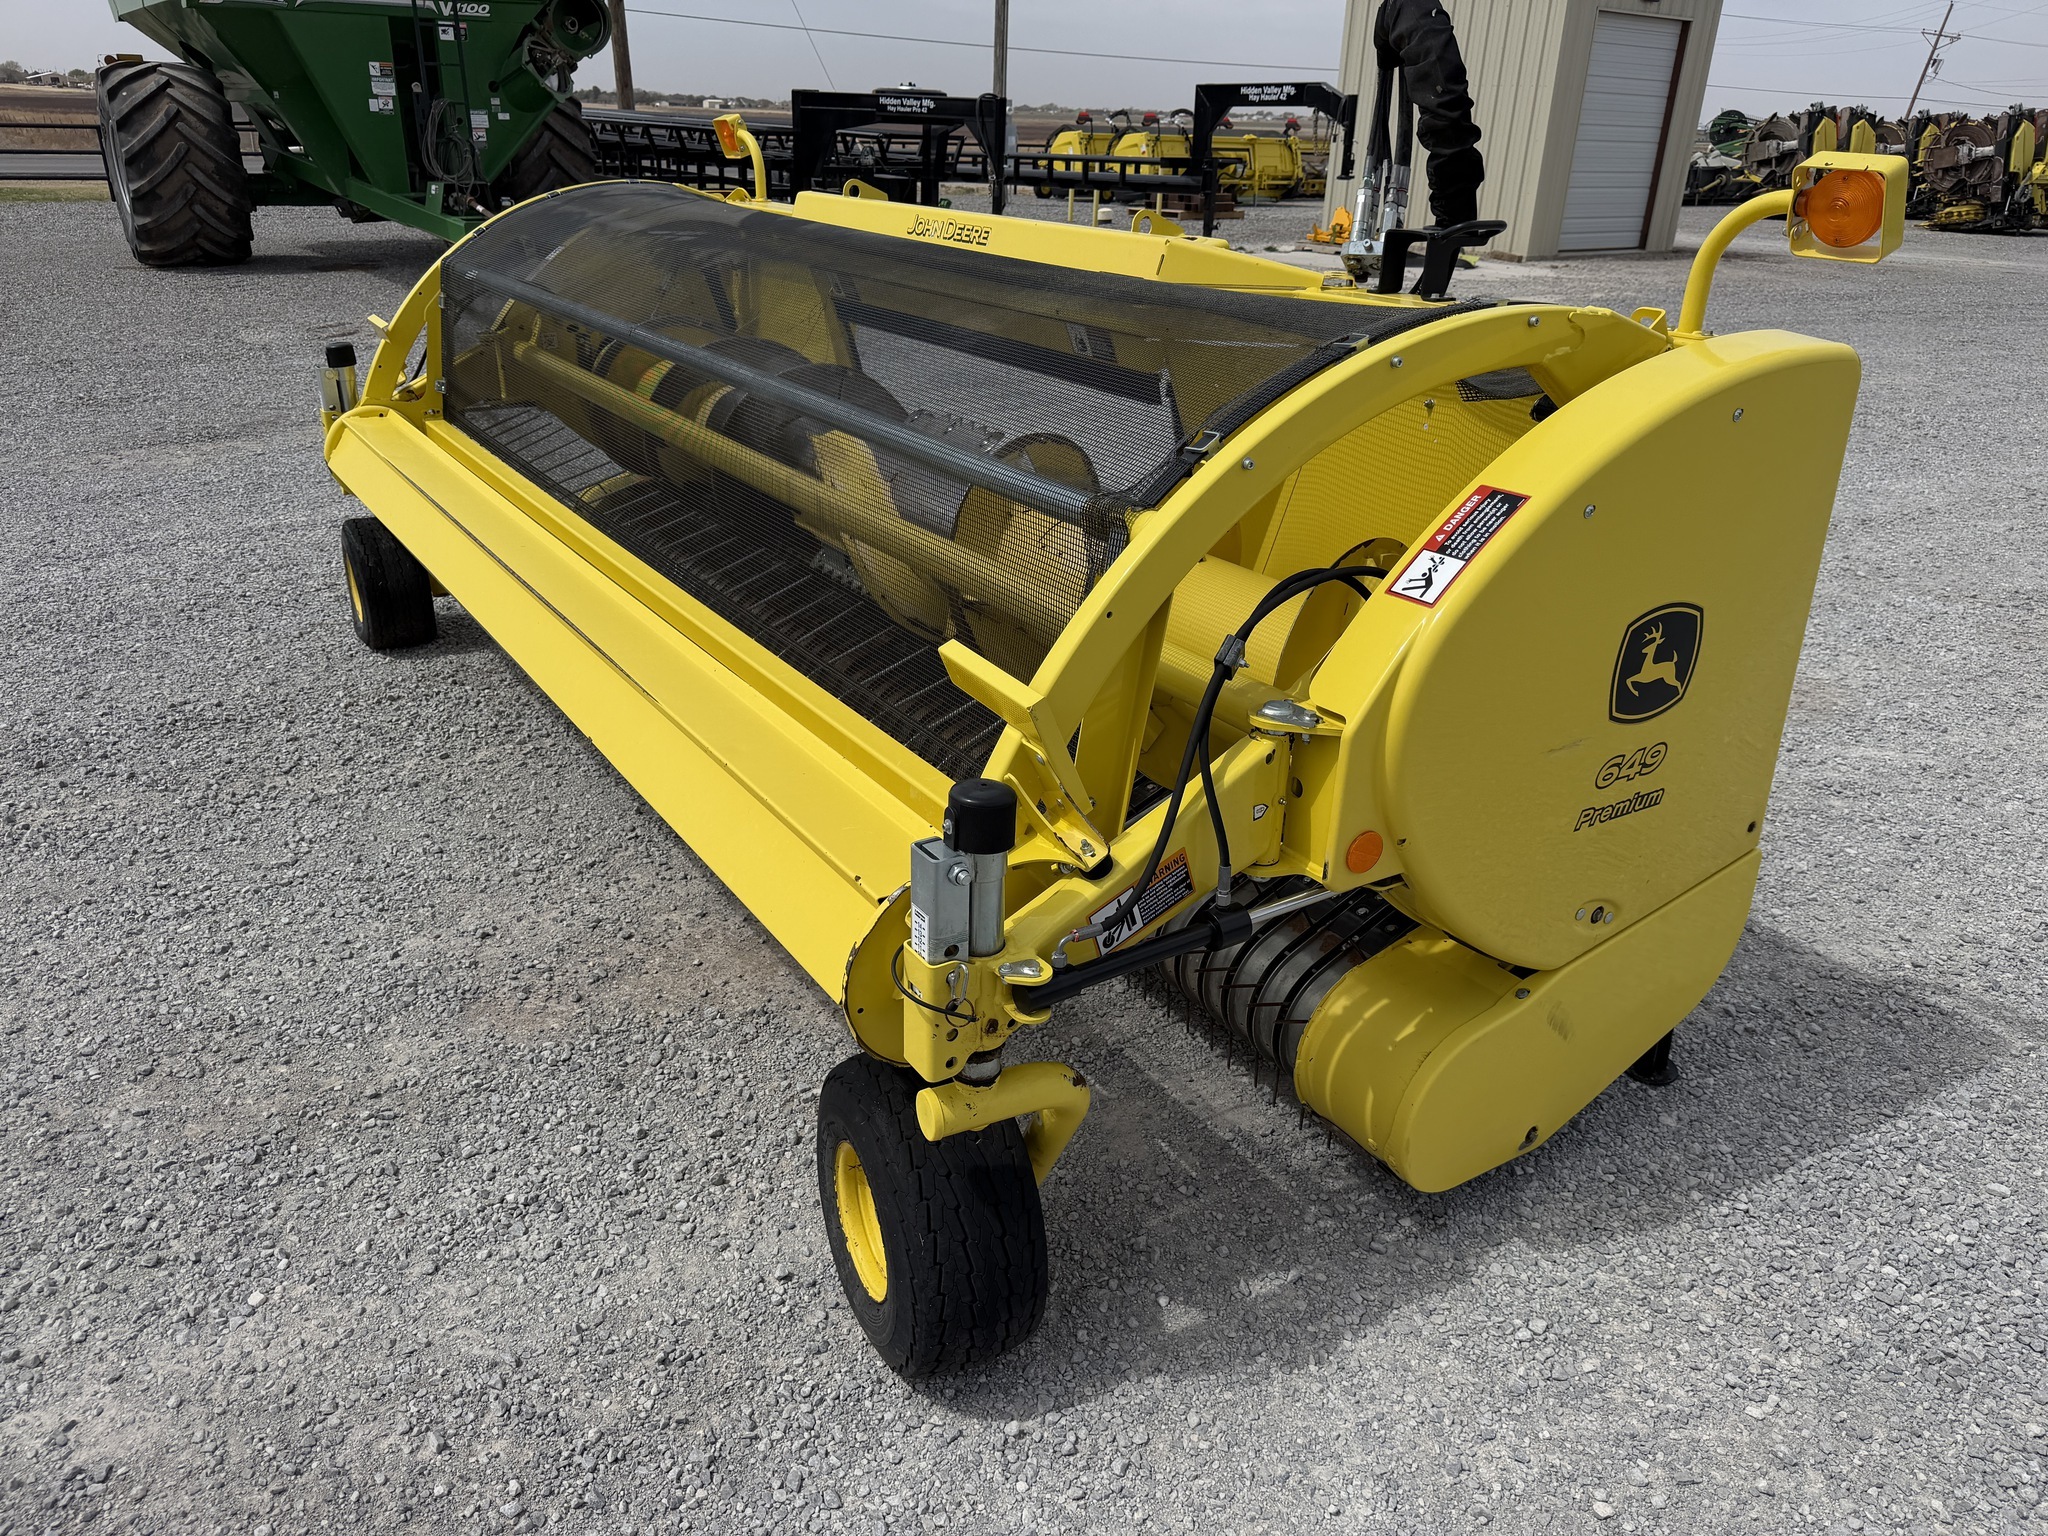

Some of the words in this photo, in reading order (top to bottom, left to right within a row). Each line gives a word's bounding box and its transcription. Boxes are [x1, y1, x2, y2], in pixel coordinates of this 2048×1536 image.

[879, 96, 901, 105] Hidden
[902, 98, 921, 107] Valley
[922, 99, 936, 108] Mfg.
[1240, 86, 1262, 94] Hidden
[1263, 86, 1282, 95] Valley
[1283, 85, 1296, 95] Mfg.
[1249, 94, 1260, 102] Hay
[907, 214, 944, 238] JOHN
[943, 218, 992, 246] DEERE
[1443, 495, 1482, 531] DANGER
[1595, 742, 1668, 790] 649
[1574, 788, 1665, 832] Premium
[1151, 853, 1185, 884] ARNING
